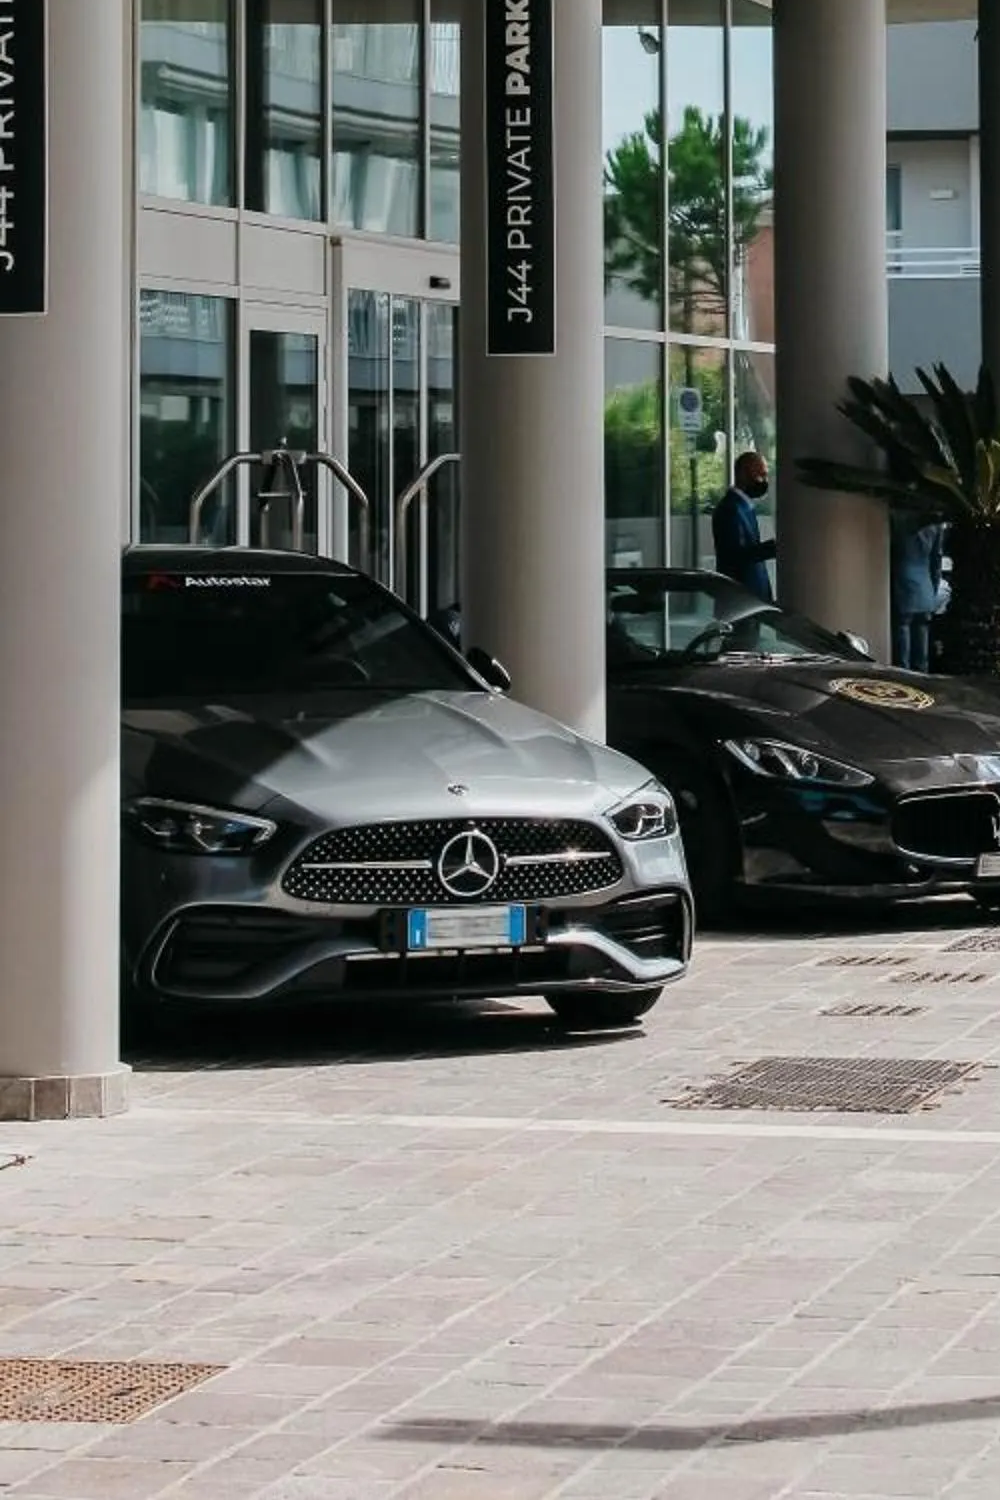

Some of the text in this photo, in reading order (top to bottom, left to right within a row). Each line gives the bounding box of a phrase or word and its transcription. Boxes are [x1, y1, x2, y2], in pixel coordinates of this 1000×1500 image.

[506, 106, 531, 249] PRIVATE
[507, 259, 532, 323] J44
[185, 576, 271, 587] Autostar
